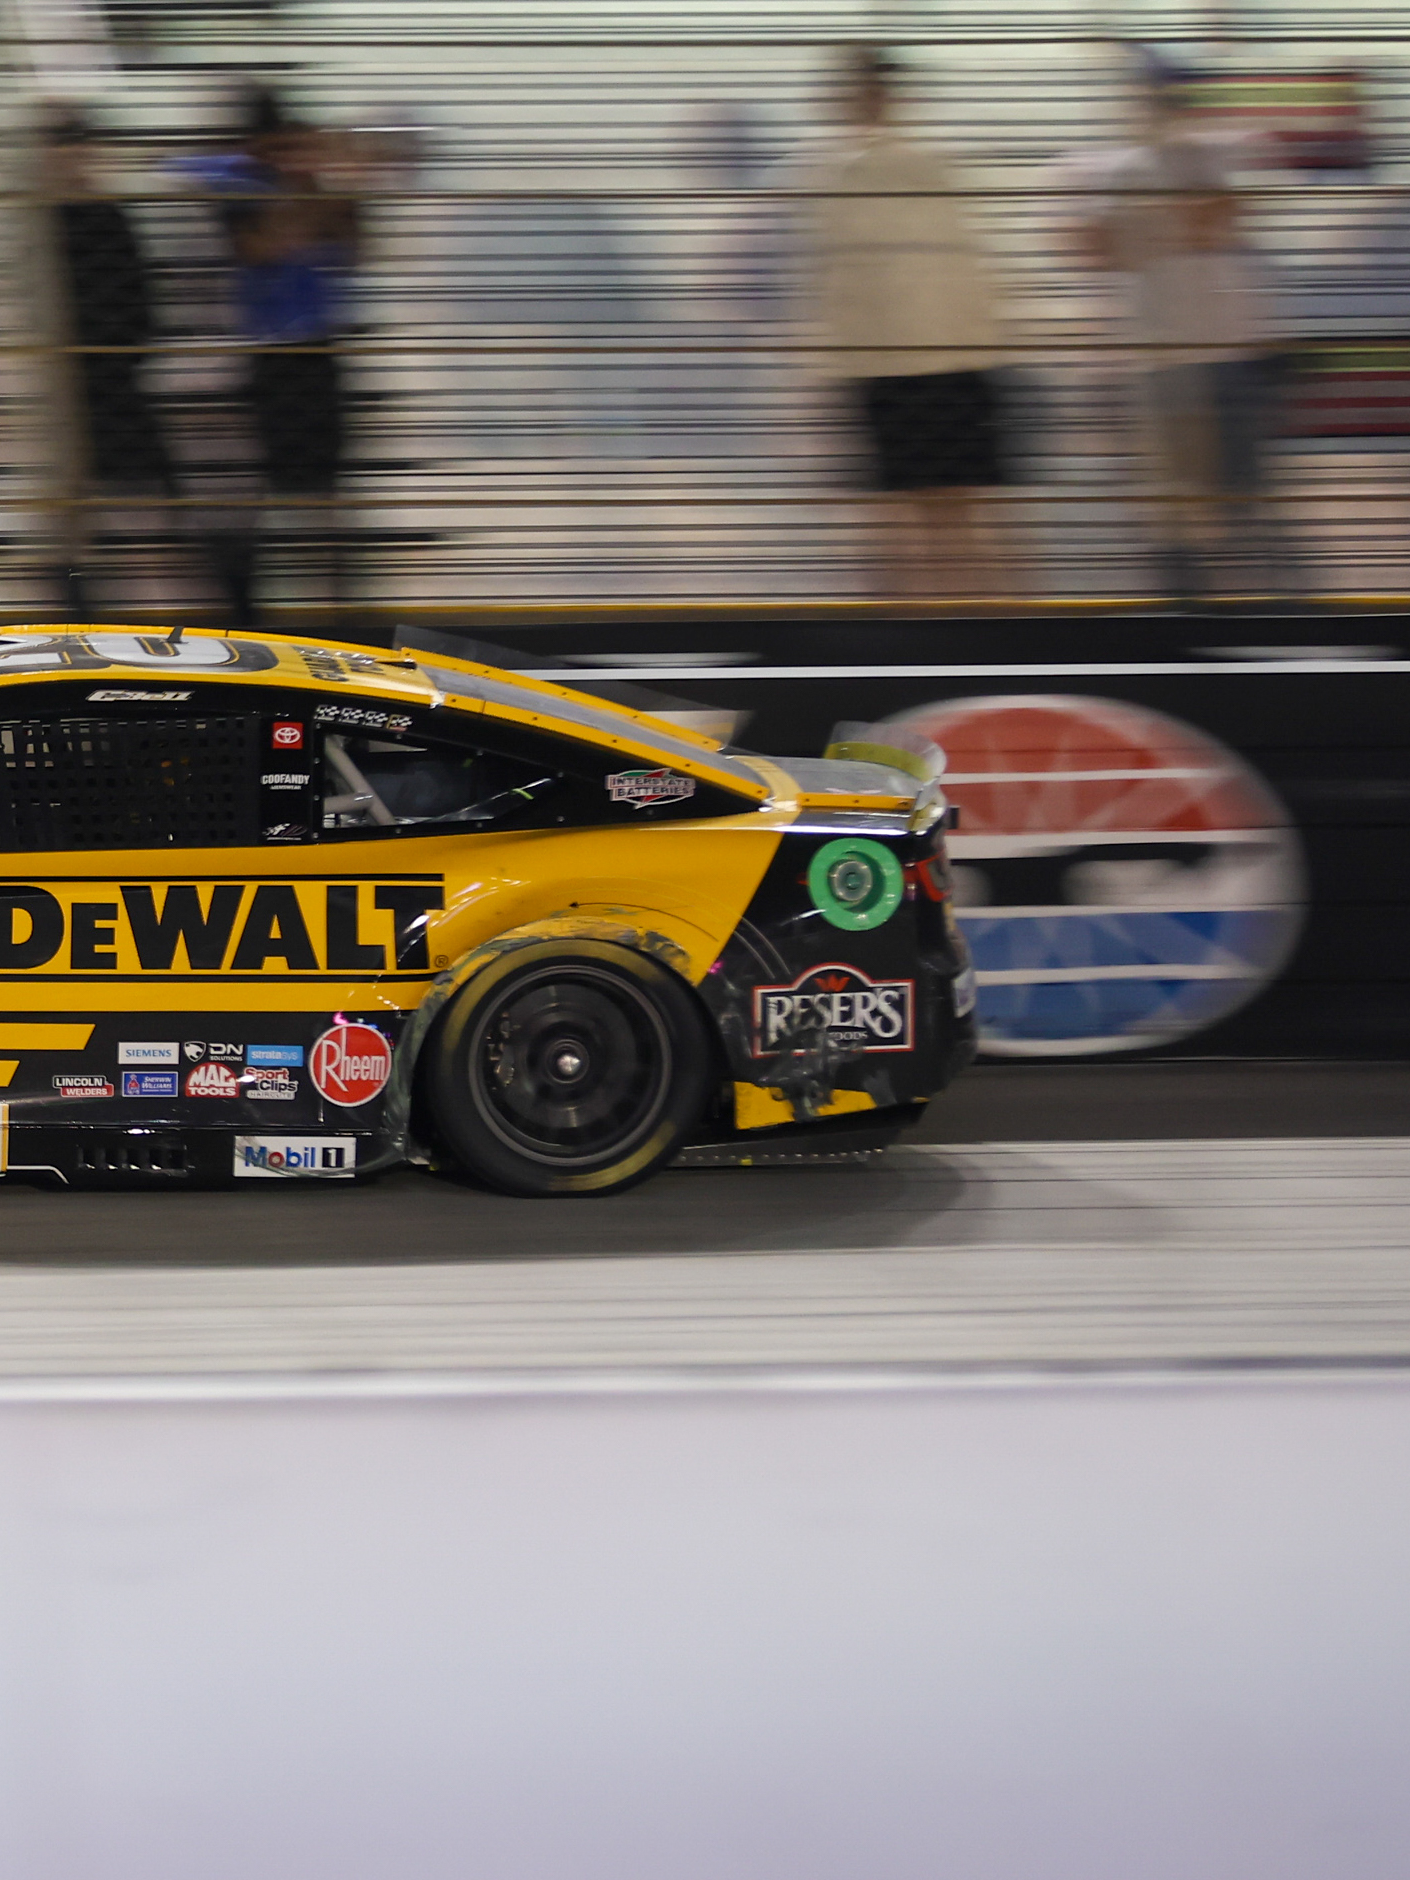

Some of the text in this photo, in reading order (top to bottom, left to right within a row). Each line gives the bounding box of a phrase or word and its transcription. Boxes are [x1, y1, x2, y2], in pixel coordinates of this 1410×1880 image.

[261, 774, 310, 785] COOFANDY
[612, 777, 691, 787] INTERSTATE
[617, 786, 690, 797] BATTERIES
[766, 988, 903, 1046] RESER'S
[125, 1048, 172, 1058] SIEMENS
[208, 1043, 244, 1056] DN
[250, 1050, 298, 1061] stratasys
[320, 1026, 386, 1092] Rheem
[244, 1067, 289, 1082] Sport
[55, 1077, 103, 1087] LINCOLN
[258, 1080, 297, 1093] Clips
[65, 1087, 108, 1096] WELDERS
[188, 1087, 237, 1096] TOOLS
[245, 1146, 342, 1168] Mobil 1
